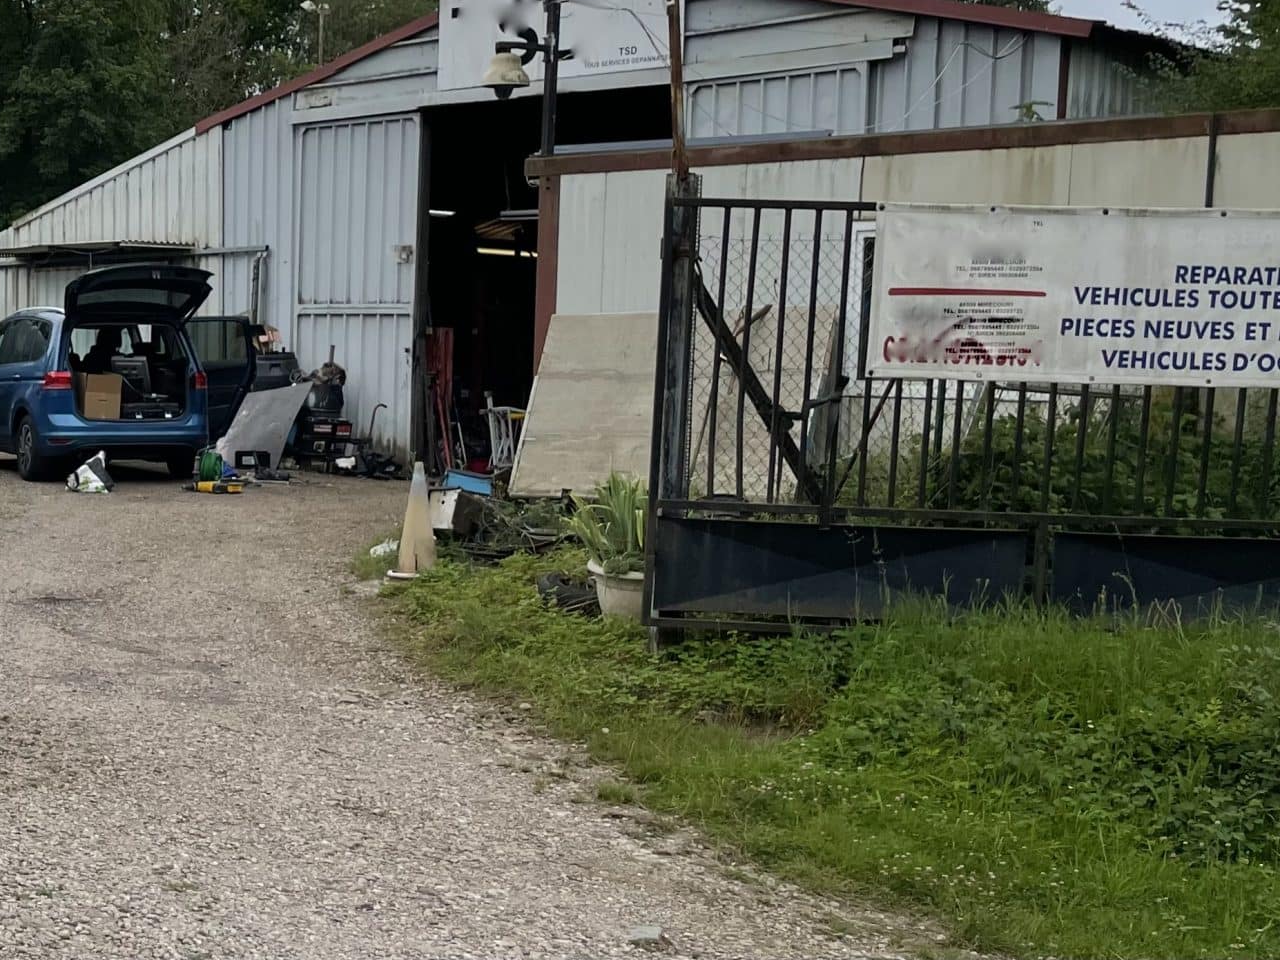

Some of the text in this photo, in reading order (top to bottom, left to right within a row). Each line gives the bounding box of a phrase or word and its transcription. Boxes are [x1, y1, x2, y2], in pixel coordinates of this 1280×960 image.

[619, 46, 638, 56] TSD
[601, 58, 630, 67] SERVICES
[1074, 287, 1200, 308] VEHICULES
[1060, 318, 1135, 338] PIECES
[1144, 320, 1235, 340] NEUVES
[1245, 322, 1271, 341] ET
[1102, 349, 1226, 371] VEHICULES
